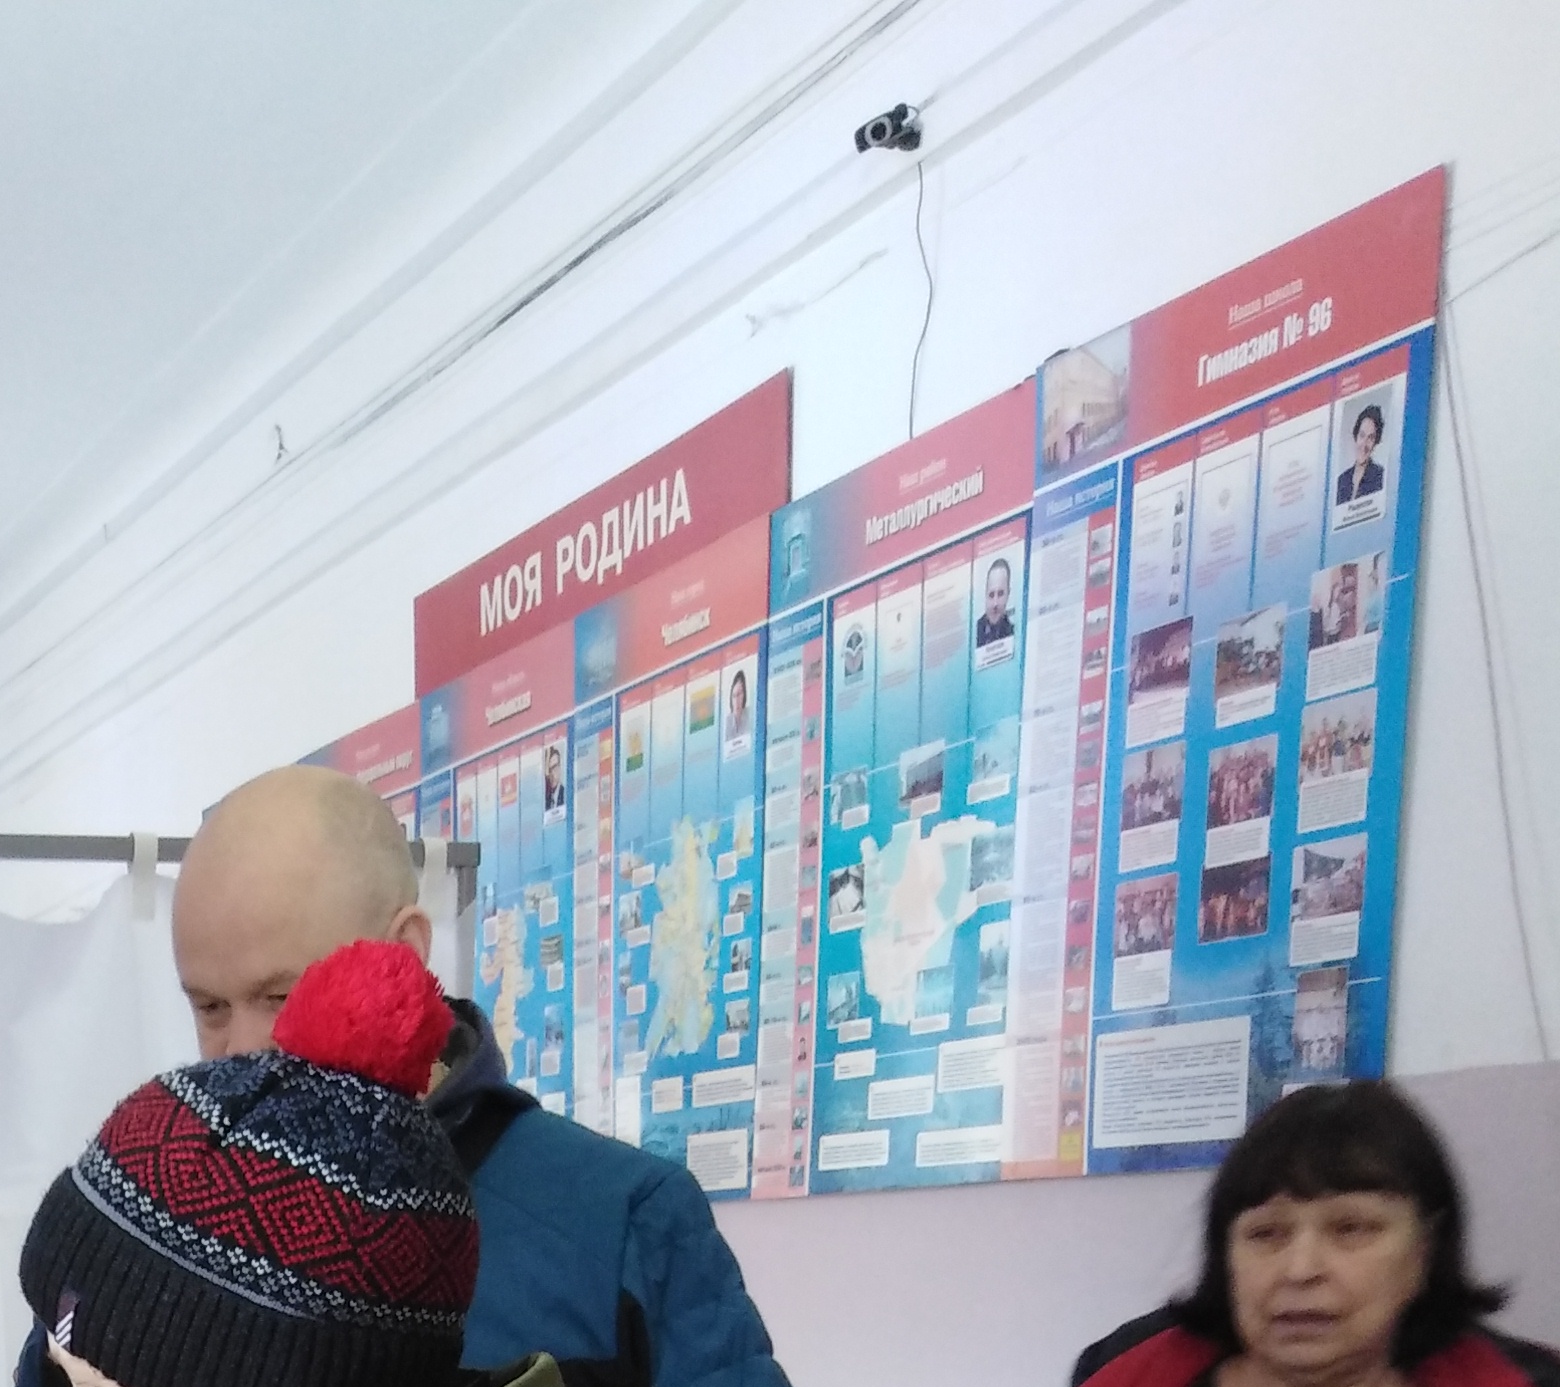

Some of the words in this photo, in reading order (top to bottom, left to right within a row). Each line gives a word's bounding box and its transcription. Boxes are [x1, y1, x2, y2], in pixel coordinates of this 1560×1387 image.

[1198, 327, 1279, 387] Гимназия
[1283, 313, 1304, 349] №
[1307, 297, 1333, 337] 96
[866, 465, 984, 546] Металлургический
[480, 551, 542, 637] МОЯ
[556, 467, 691, 595] РОДИНА
